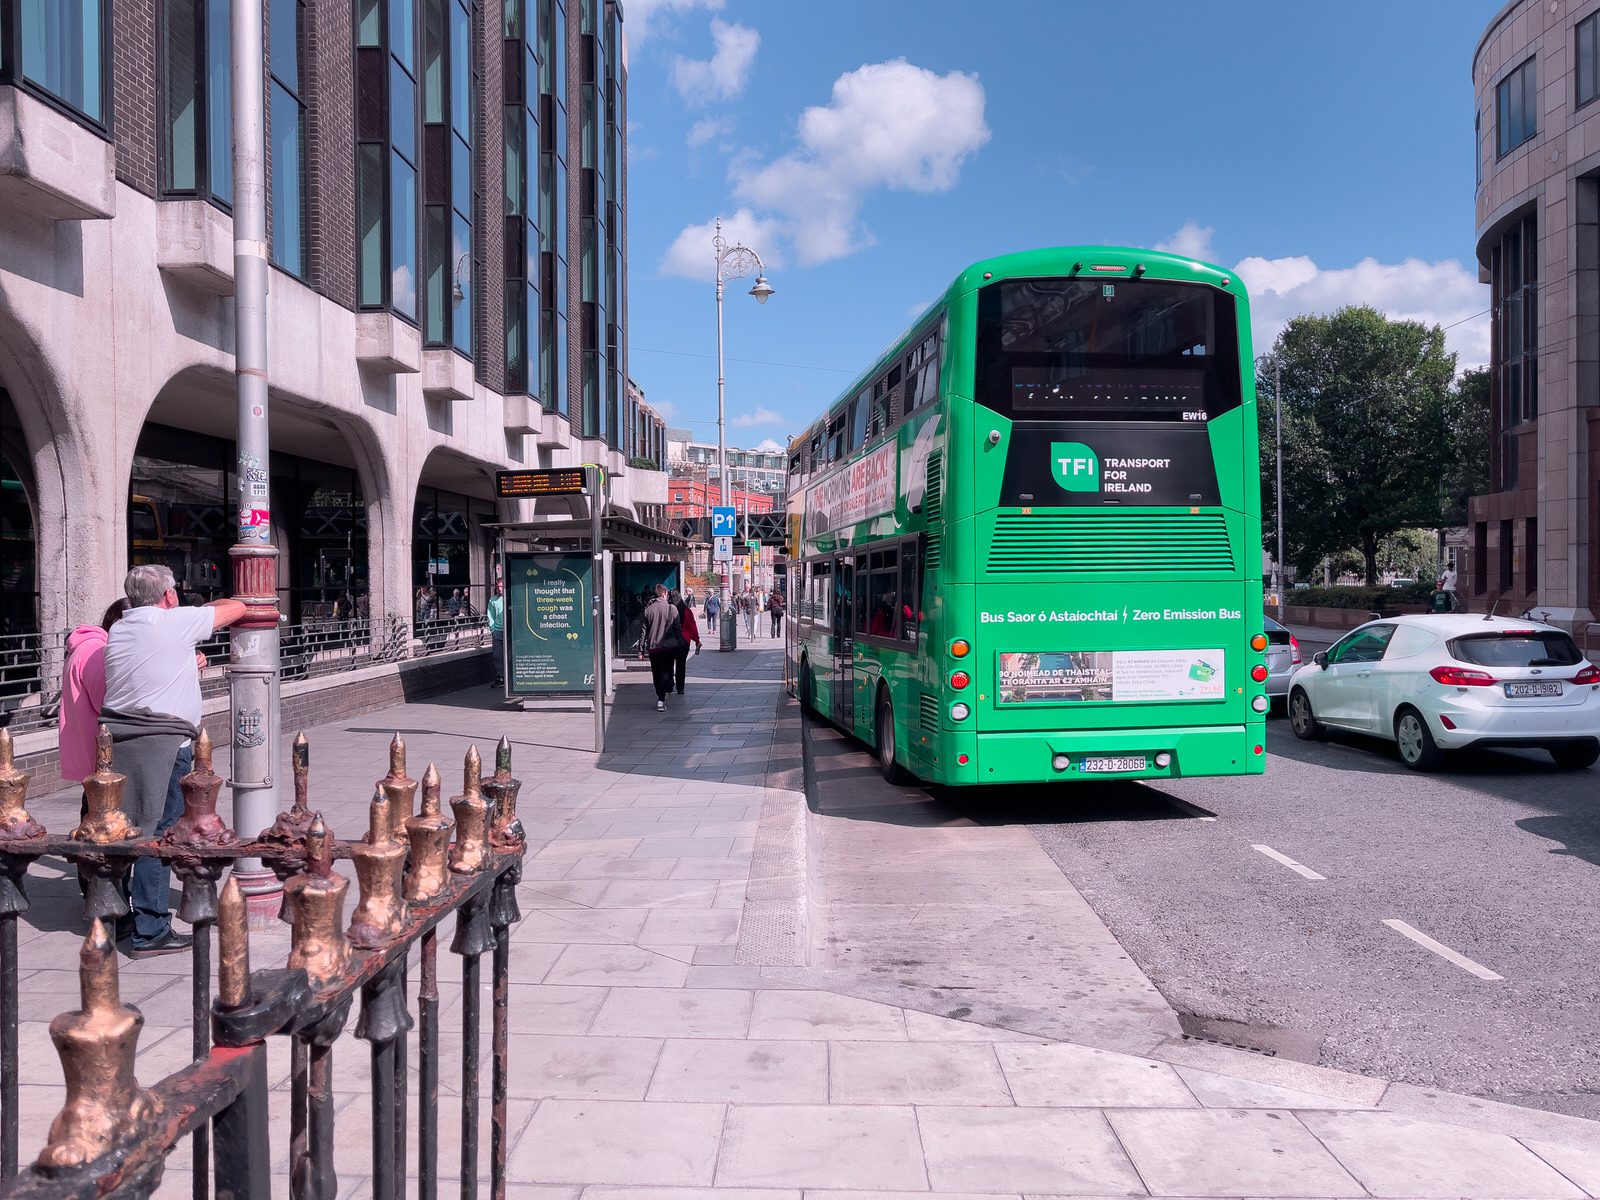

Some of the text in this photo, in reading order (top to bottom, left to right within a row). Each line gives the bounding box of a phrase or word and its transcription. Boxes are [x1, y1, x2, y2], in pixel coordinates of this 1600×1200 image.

[1183, 412, 1207, 421] EW16
[1057, 458, 1093, 475] TFI
[1104, 458, 1170, 468] TRANSPORT
[851, 463, 865, 492] ARE
[866, 448, 888, 487] BACK!
[1104, 471, 1127, 480] FOR
[1104, 483, 1152, 493] IRELAND
[714, 514, 725, 529] P
[547, 579, 565, 587] really
[534, 588, 561, 596] thought
[981, 608, 1241, 623] Bus Saor ó Astaíochtaí Zero Emission Bus
[540, 621, 571, 629] infection.
[1087, 759, 1145, 770] 232-D-28068
